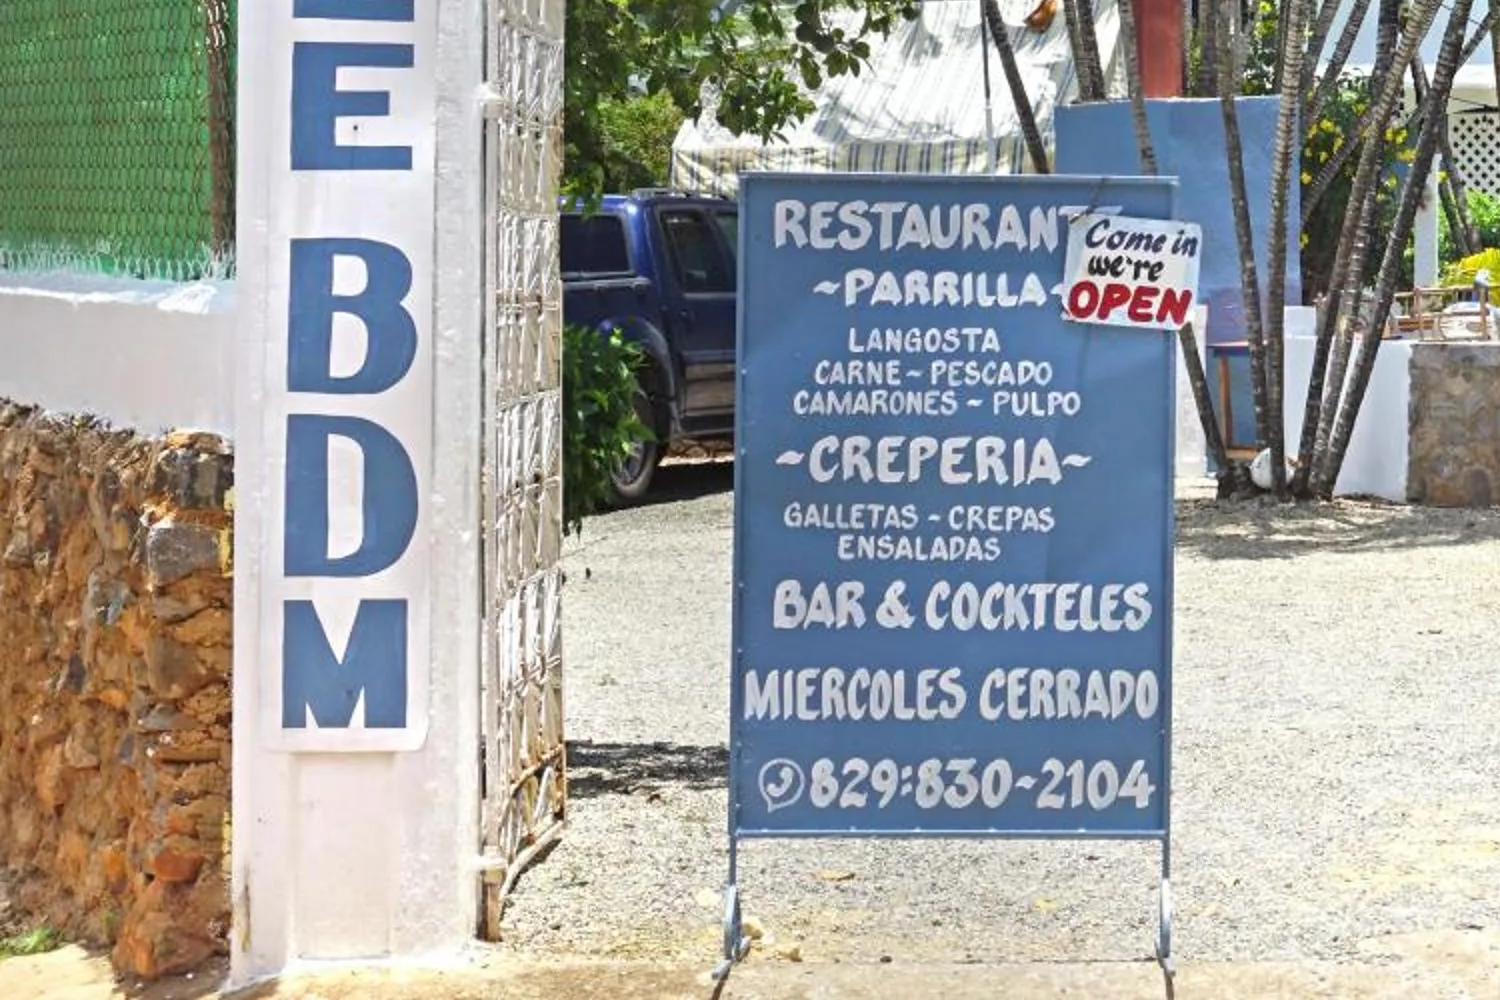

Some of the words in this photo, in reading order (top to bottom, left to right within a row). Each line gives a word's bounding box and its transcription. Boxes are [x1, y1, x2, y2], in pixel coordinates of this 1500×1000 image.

[774, 199, 1123, 253] RESTAURAN
[1085, 218, 1168, 254] Come
[1171, 229, 1199, 259] in
[1067, 279, 1193, 326] OPEN
[848, 327, 1001, 353] LANGOSTA
[814, 359, 901, 386] CARNE
[930, 360, 1053, 387] PESCADO
[792, 389, 959, 417] CAMARONES
[992, 391, 1082, 417] PULPO
[783, 502, 918, 530] GALLETAS
[948, 505, 1056, 532] CREPAS
[837, 534, 1002, 561] ENSALADAS
[772, 579, 865, 631] BAR
[875, 580, 915, 630] &
[925, 580, 1153, 633] COCKTELES
[743, 666, 968, 722] MIERCOLES
[979, 667, 1160, 721] CERRADO
